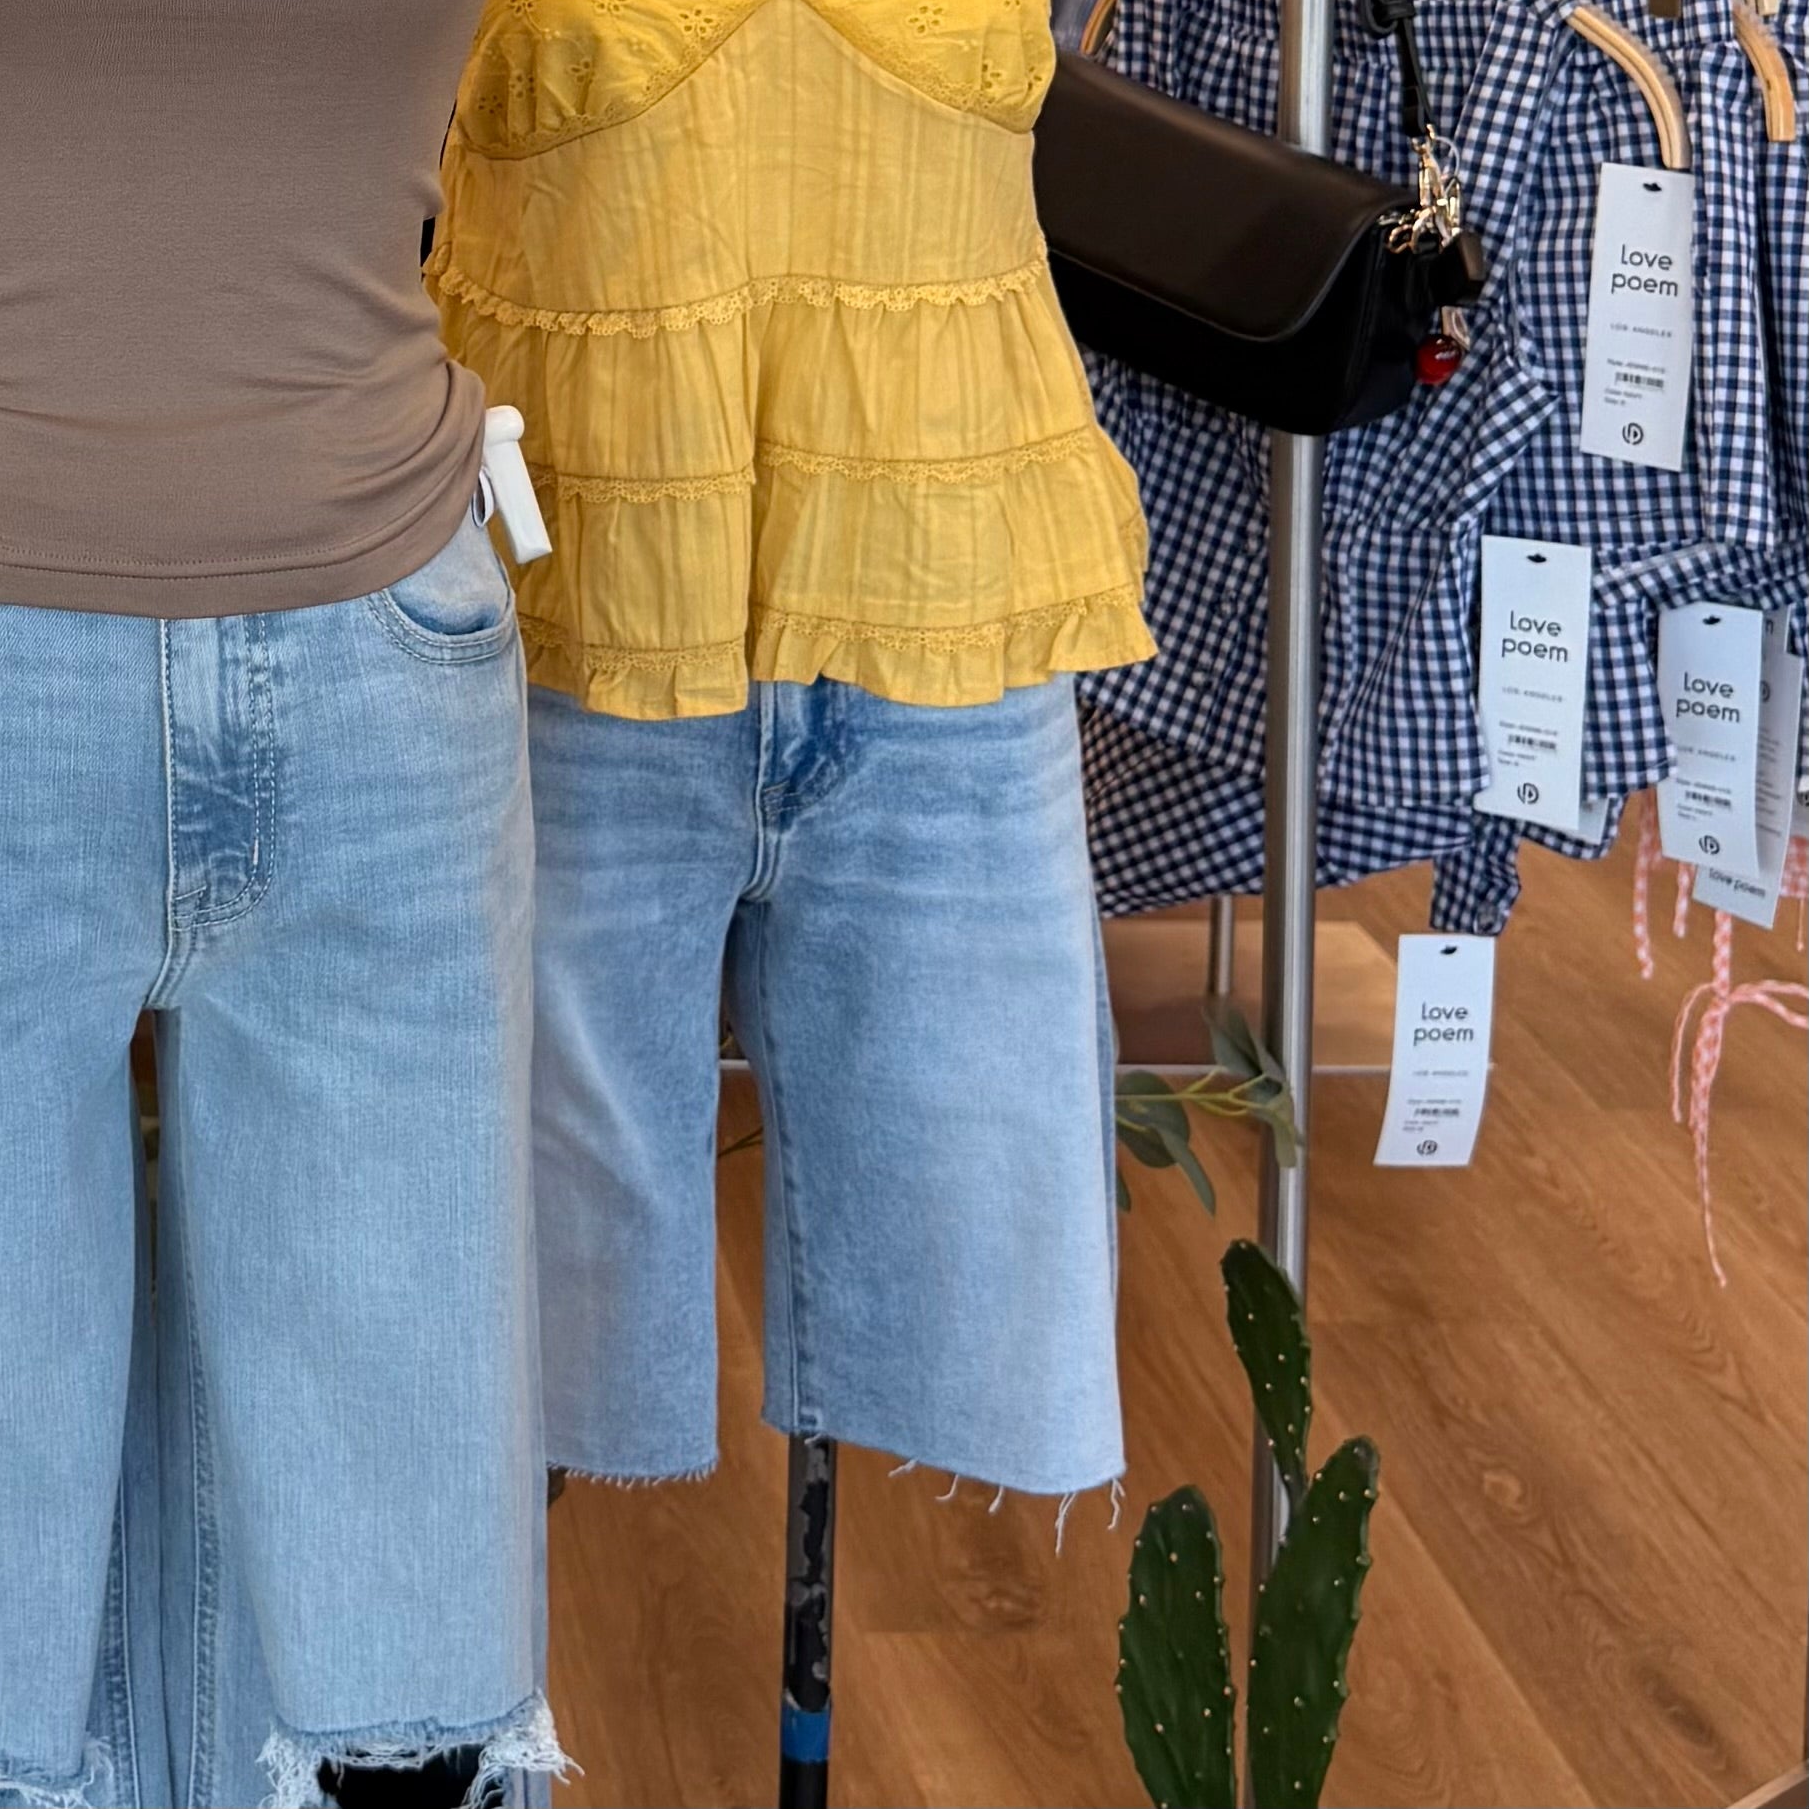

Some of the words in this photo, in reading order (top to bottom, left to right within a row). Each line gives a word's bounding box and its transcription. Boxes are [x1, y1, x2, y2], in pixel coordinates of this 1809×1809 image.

[1610, 272, 1679, 297] poem
[1501, 638, 1569, 663] poem
[1675, 698, 1741, 723] poem
[1413, 1026, 1475, 1047] poem
